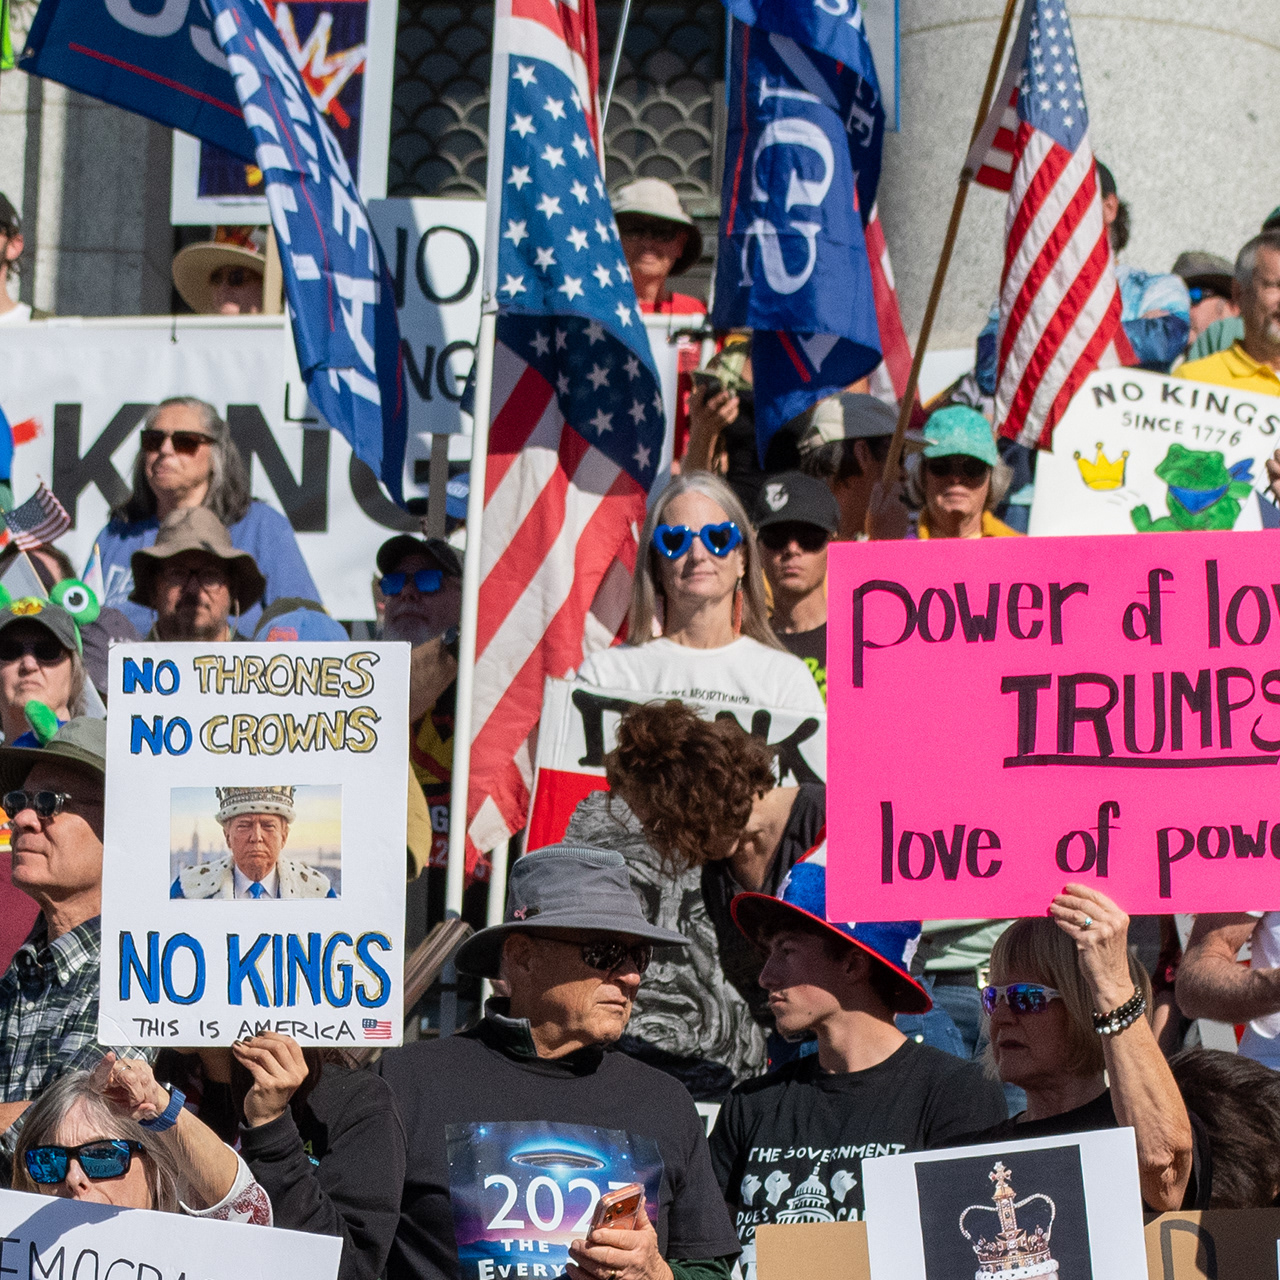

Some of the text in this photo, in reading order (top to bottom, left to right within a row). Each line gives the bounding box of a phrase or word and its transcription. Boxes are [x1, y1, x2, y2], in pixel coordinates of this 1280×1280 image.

[1091, 381, 1144, 410] NO
[1120, 410, 1242, 448] SINCE 1776
[1120, 567, 1177, 646] of
[121, 651, 381, 699] NO THRONES
[129, 705, 382, 756] NO CROWNS
[879, 800, 1003, 885] love
[1055, 800, 1121, 878] of
[118, 929, 394, 1009] NO KINGS
[132, 1017, 357, 1042] THIS IS AMERICA
[748, 1142, 907, 1164] THE GOVERNMENT
[483, 1173, 638, 1233] 202
[736, 1205, 771, 1227] DOES
[500, 1238, 550, 1253] THE
